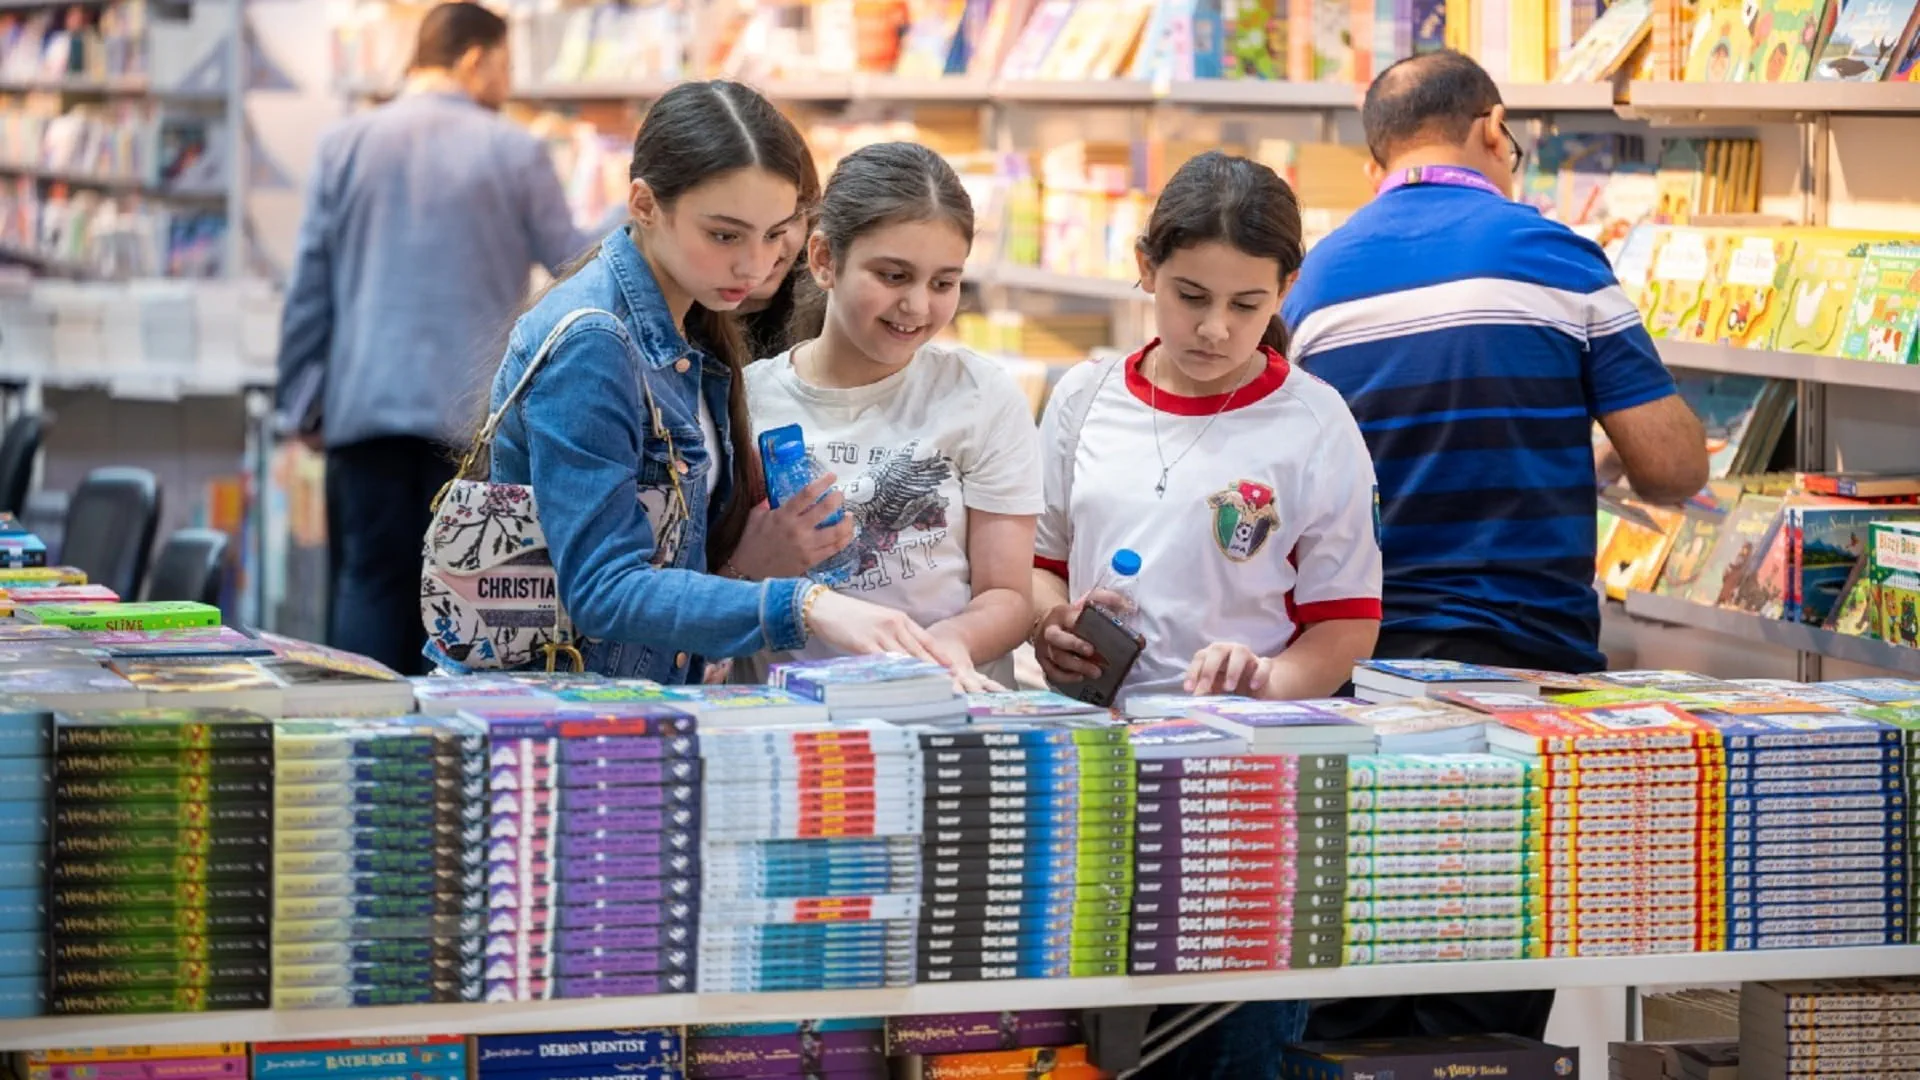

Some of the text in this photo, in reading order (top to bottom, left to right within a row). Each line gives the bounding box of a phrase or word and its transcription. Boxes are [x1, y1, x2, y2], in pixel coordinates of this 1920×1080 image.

[828, 441, 860, 464] TO
[539, 1041, 589, 1058] DEMON
[591, 1039, 647, 1054] DENTIST
